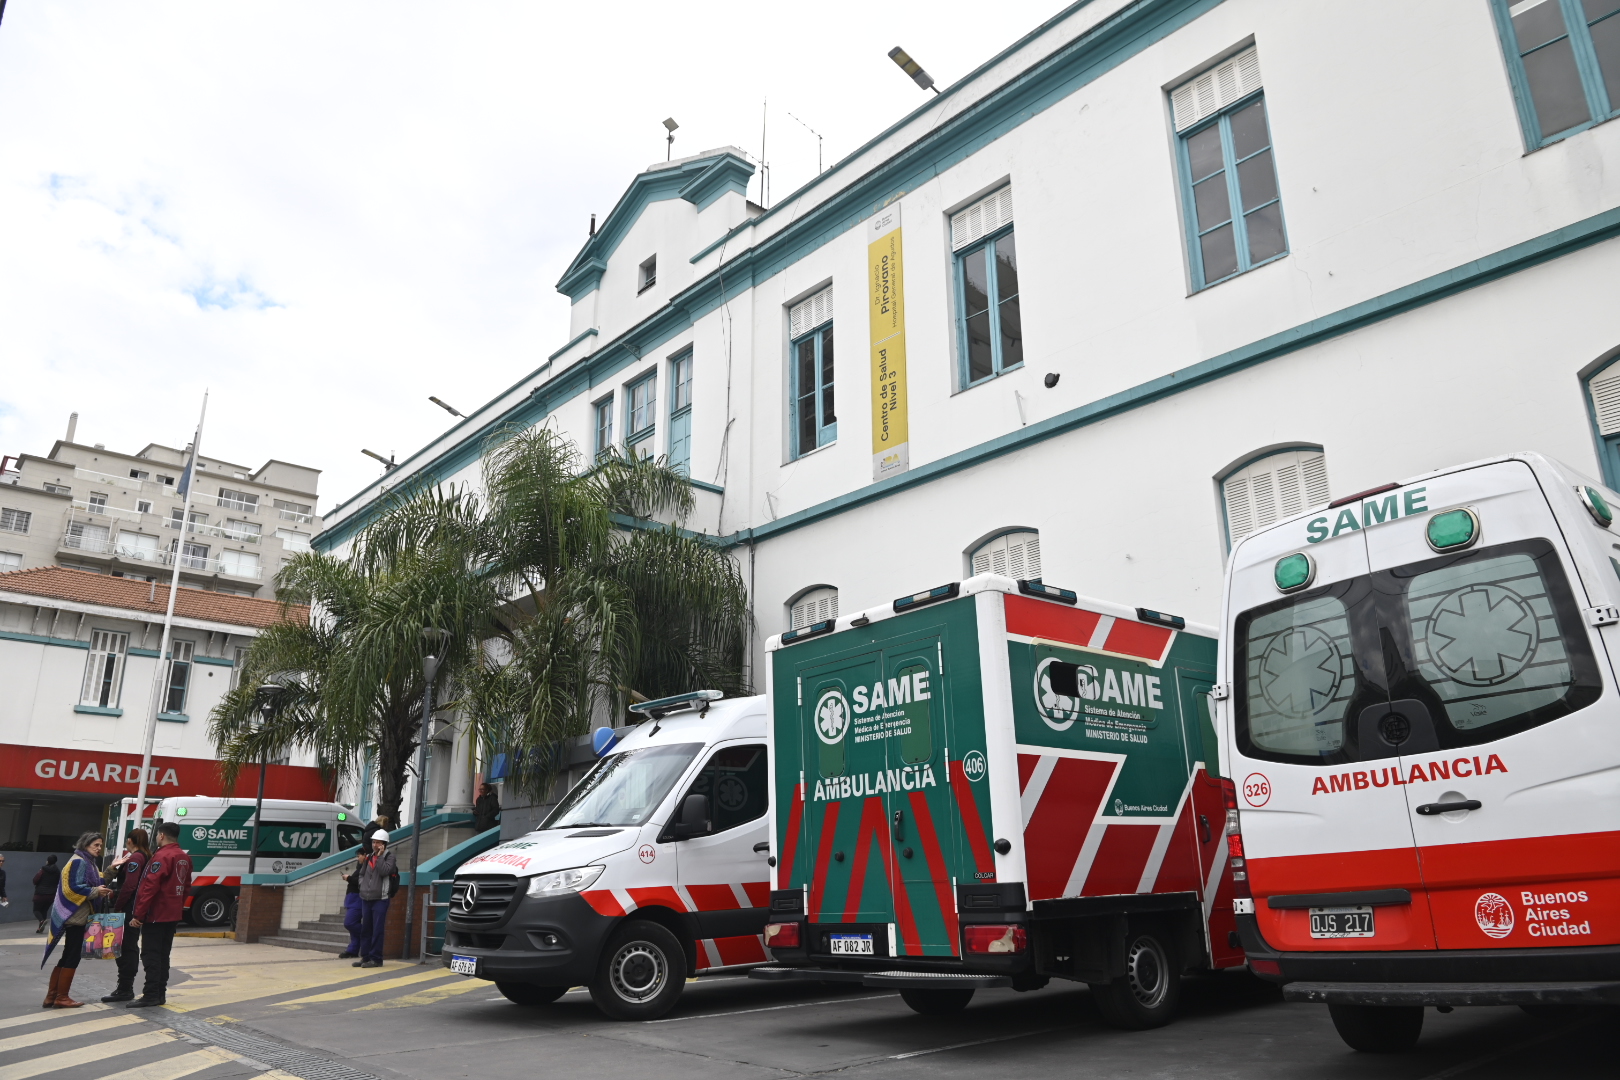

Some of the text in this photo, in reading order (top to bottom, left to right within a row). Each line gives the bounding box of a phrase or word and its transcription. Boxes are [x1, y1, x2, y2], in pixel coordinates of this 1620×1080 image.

[890, 262, 896, 271] de
[881, 255, 890, 314] Pirovano
[878, 348, 889, 442] Centro de Salud
[888, 381, 898, 412] Nivel
[1306, 486, 1428, 544] SAME
[852, 670, 932, 714] SAME
[1084, 704, 1140, 720] Sistema de Atención
[854, 716, 874, 726] Sistema
[1106, 720, 1114, 728] de
[854, 726, 912, 744] MINISTERIO DE SALUD
[1086, 729, 1148, 744] MINISTERIO DE SALUD
[34, 758, 180, 787] GUARDIA
[965, 756, 984, 775] 406
[813, 764, 937, 802] AMBULANCIA
[1311, 753, 1508, 796] AMBULANCIA
[1246, 782, 1269, 798] 326
[208, 828, 248, 840] SAME
[289, 832, 326, 848] 107
[1520, 889, 1588, 906] Buenos
[1312, 914, 1370, 932] OJS 217
[1525, 907, 1570, 922] Aires
[1528, 920, 1591, 938] Ciudad
[832, 940, 872, 952] AF 082 JR
[452, 960, 458, 971] AF
